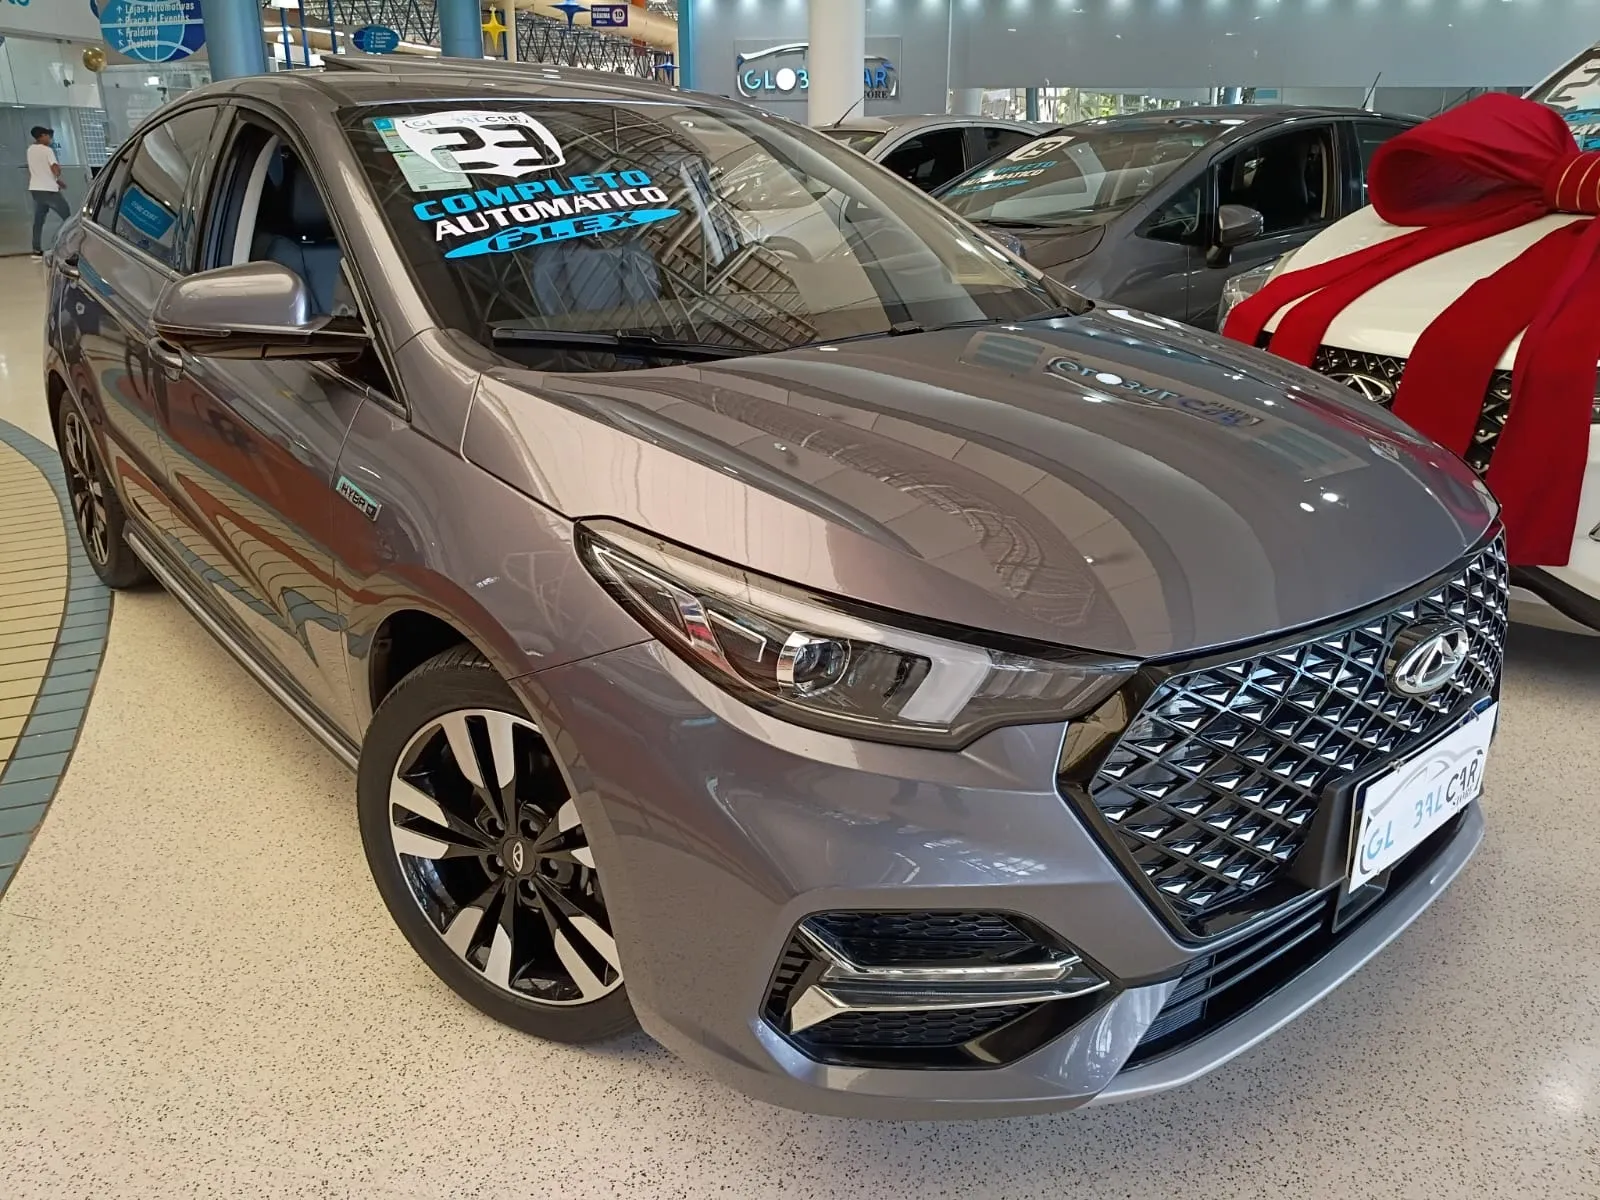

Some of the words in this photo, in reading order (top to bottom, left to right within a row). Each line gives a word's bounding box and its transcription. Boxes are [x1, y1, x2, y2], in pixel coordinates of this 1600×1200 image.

[126, 4, 145, 15] Lojas
[147, 2, 195, 13] Automotivas
[160, 13, 190, 24] Eventos
[126, 27, 158, 38] Fraldário
[744, 68, 809, 91] GLOB
[864, 68, 888, 89] AR
[864, 90, 888, 99] ORE
[418, 124, 560, 171] 23
[413, 170, 653, 222] COMPLETO
[488, 211, 642, 252] FLEX
[341, 483, 377, 516] HYBRD
[1366, 784, 1443, 860] GLBAL
[1446, 758, 1478, 803] CAR
